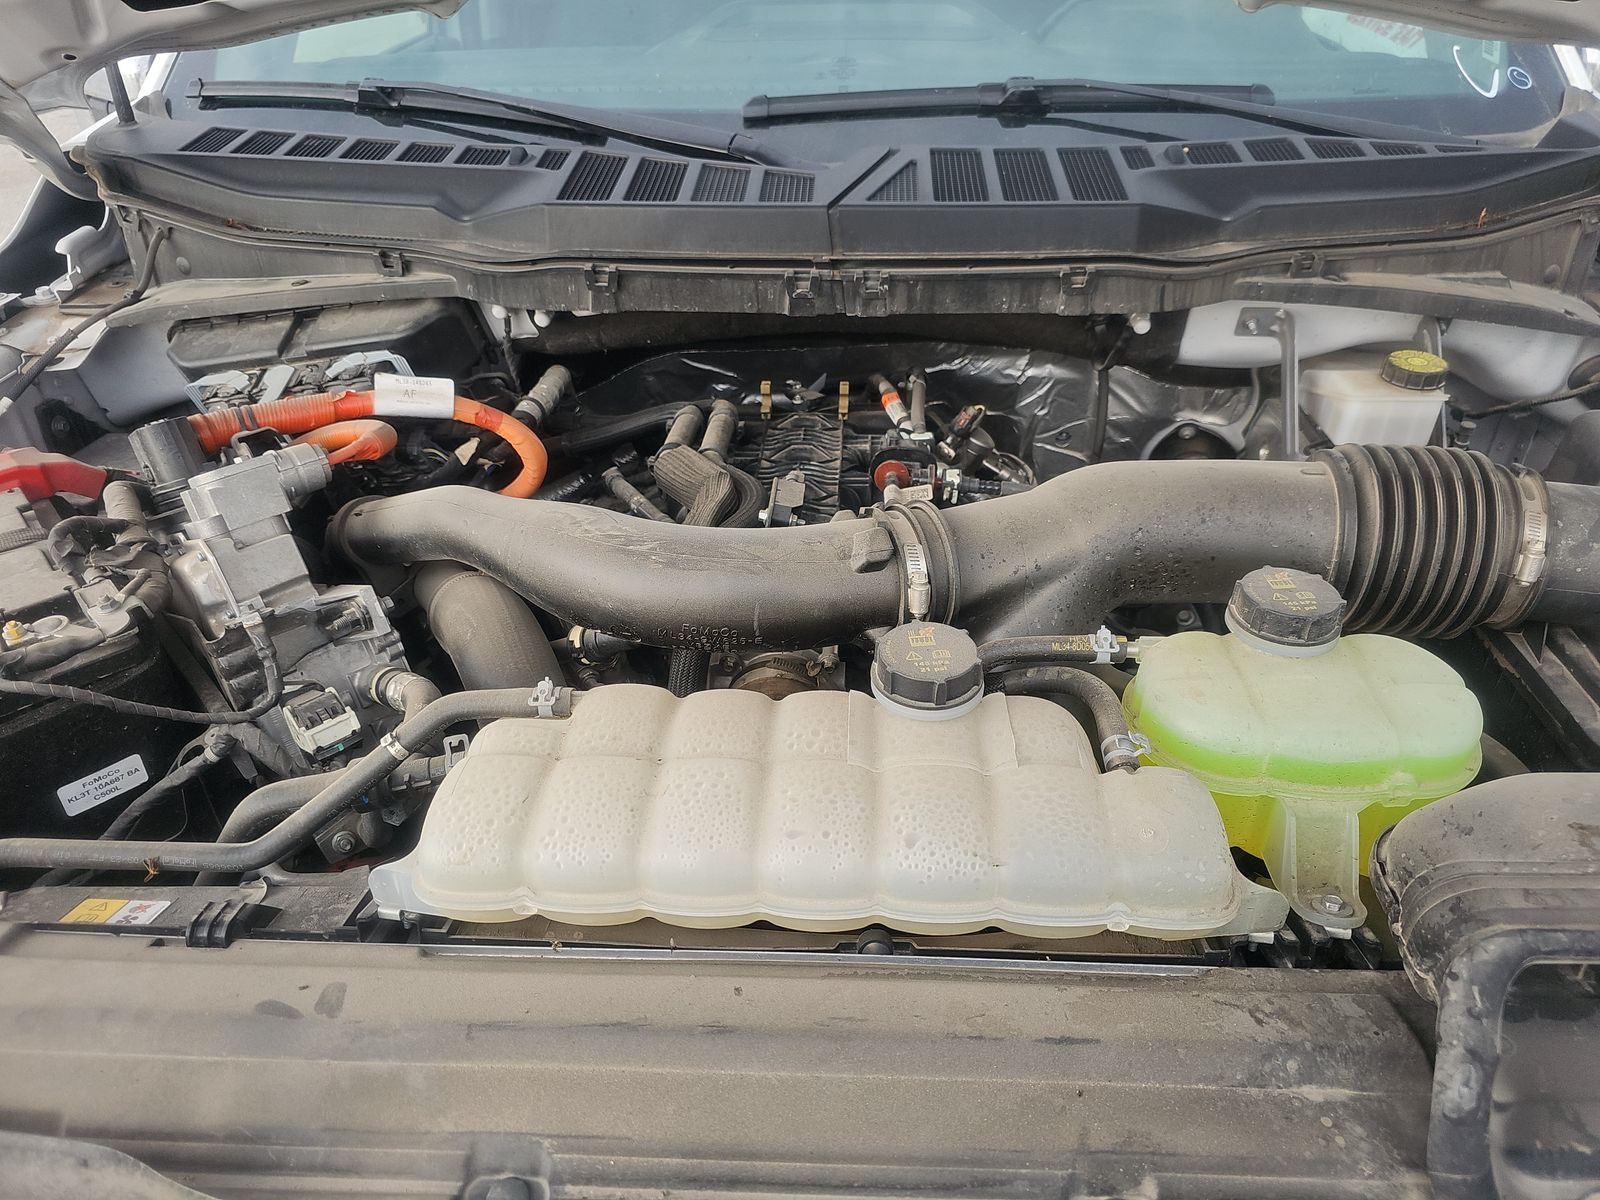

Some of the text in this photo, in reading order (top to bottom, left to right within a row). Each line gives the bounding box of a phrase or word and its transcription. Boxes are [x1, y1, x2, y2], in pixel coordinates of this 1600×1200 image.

[402, 389, 417, 398] AF
[682, 623, 738, 637] FoMoCo
[67, 766, 141, 805] KL3T 10A687 BA
[82, 767, 121, 789] FoMoCo
[93, 785, 122, 802] C500L
